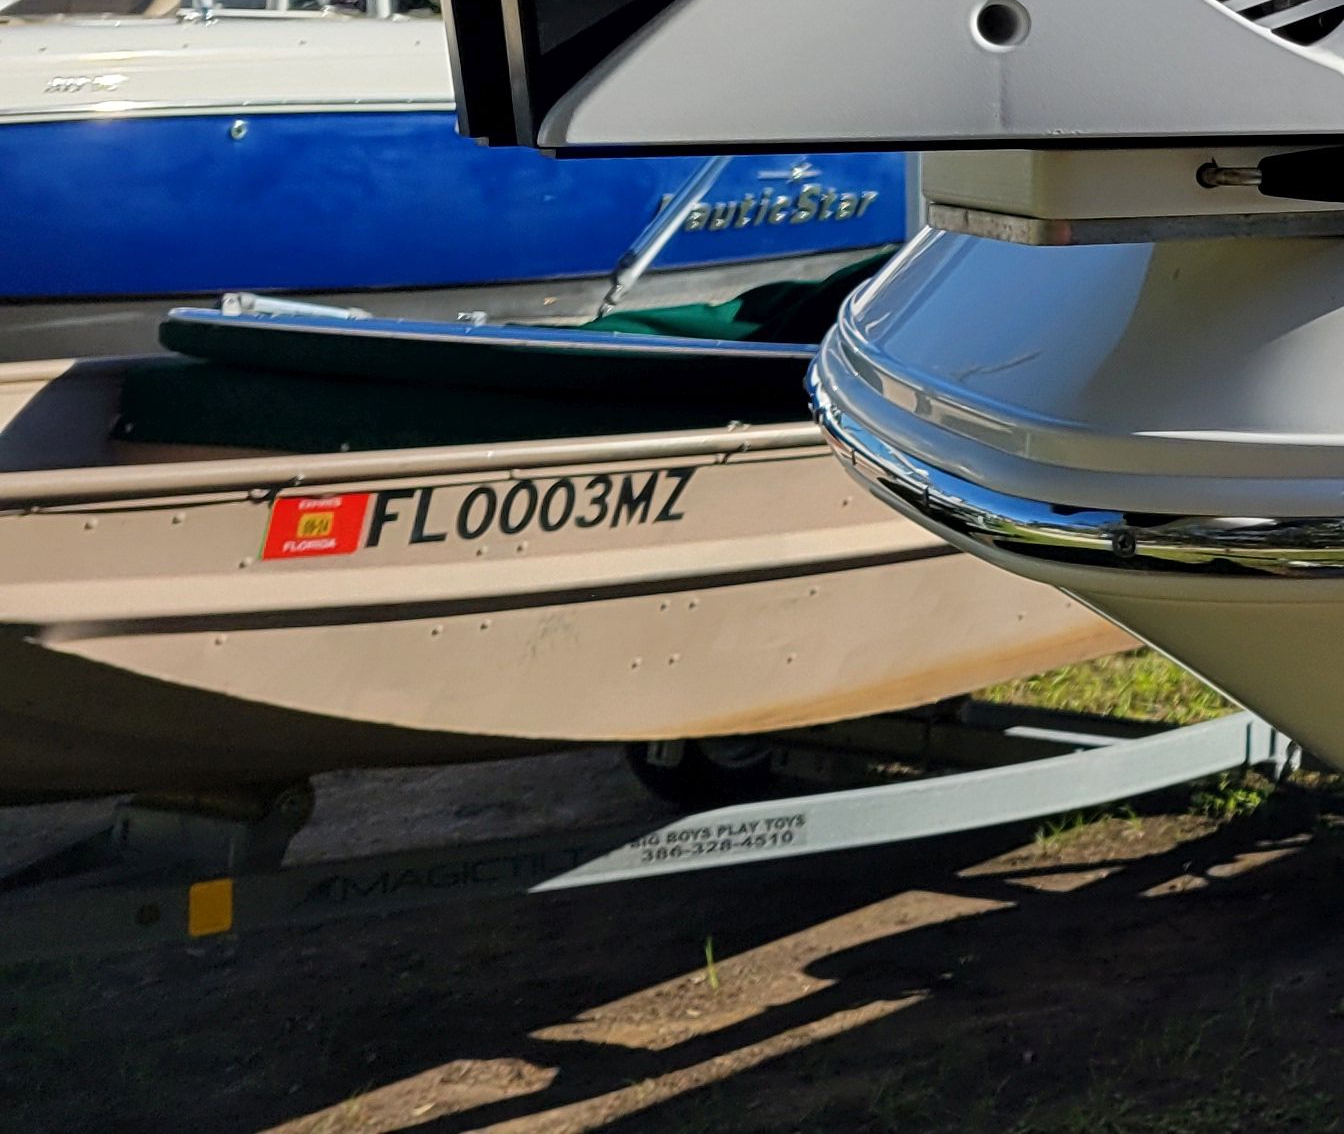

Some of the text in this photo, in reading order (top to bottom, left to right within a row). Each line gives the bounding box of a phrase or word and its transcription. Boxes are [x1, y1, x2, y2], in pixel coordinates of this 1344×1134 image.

[666, 827, 711, 844] BOYS
[716, 821, 759, 838] PLAY
[765, 813, 807, 832] TOYS
